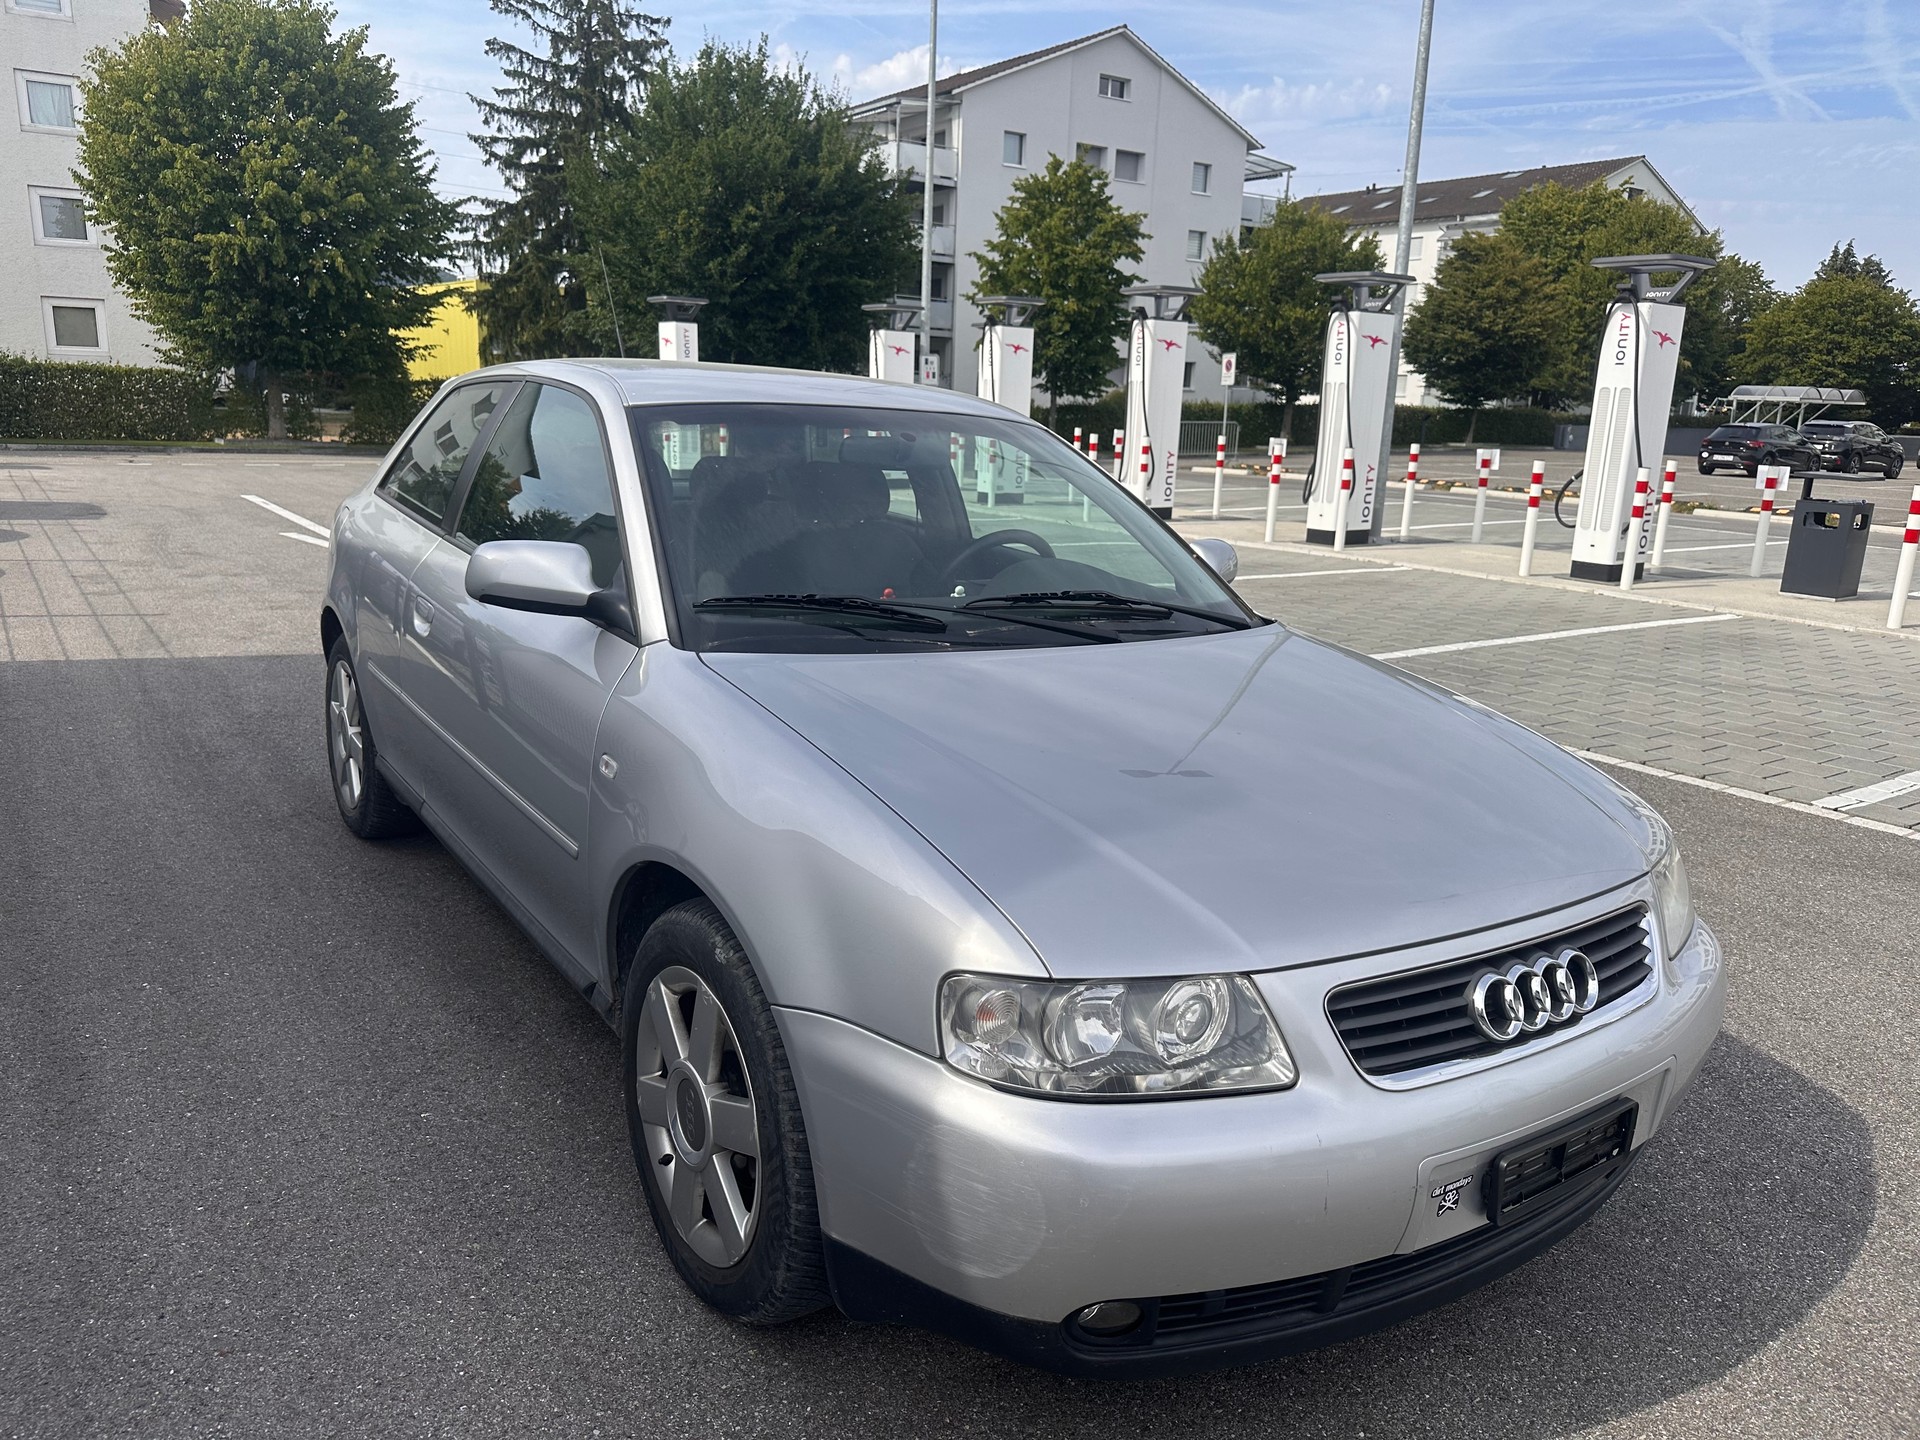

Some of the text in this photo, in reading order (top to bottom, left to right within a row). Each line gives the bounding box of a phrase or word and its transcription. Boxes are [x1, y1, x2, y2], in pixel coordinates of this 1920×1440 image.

[1335, 321, 1345, 365] IONITY
[1615, 313, 1631, 365] IONITY
[1164, 451, 1175, 502] IONITY
[1361, 464, 1375, 523] IONITY
[1638, 486, 1655, 555] IONITY
[1432, 1176, 1473, 1197] dirt mondays
